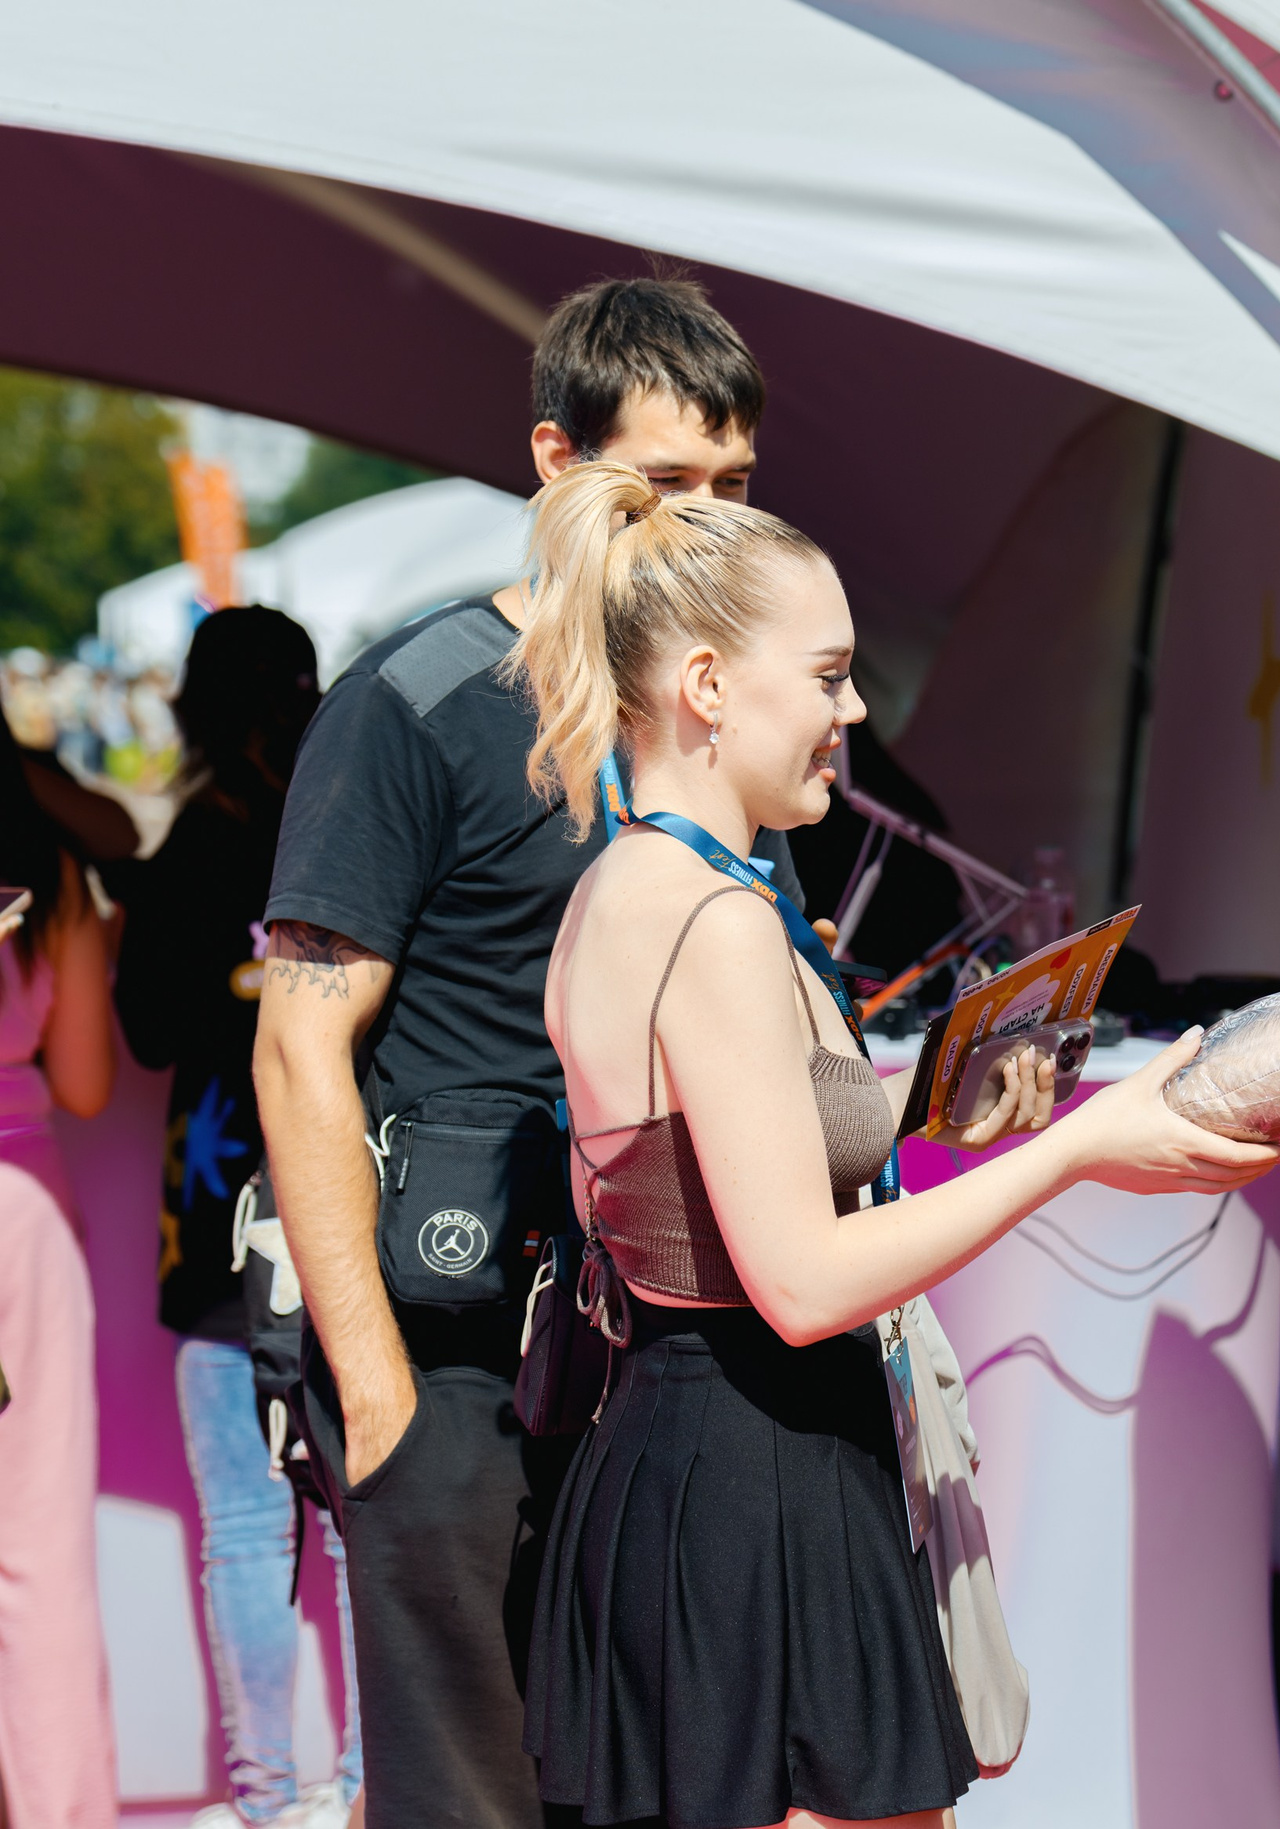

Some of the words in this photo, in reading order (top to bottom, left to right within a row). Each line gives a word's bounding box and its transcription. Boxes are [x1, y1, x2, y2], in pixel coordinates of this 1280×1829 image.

[728, 861, 754, 885] FITNESS
[750, 877, 778, 903] DDX
[833, 990, 851, 1016] FITNESS
[1062, 967, 1084, 1013] DDXFEST
[1031, 1003, 1045, 1016] НА
[845, 1015, 863, 1042] DDX
[943, 1040, 958, 1077] HAL20
[433, 1212, 478, 1231] PARIS
